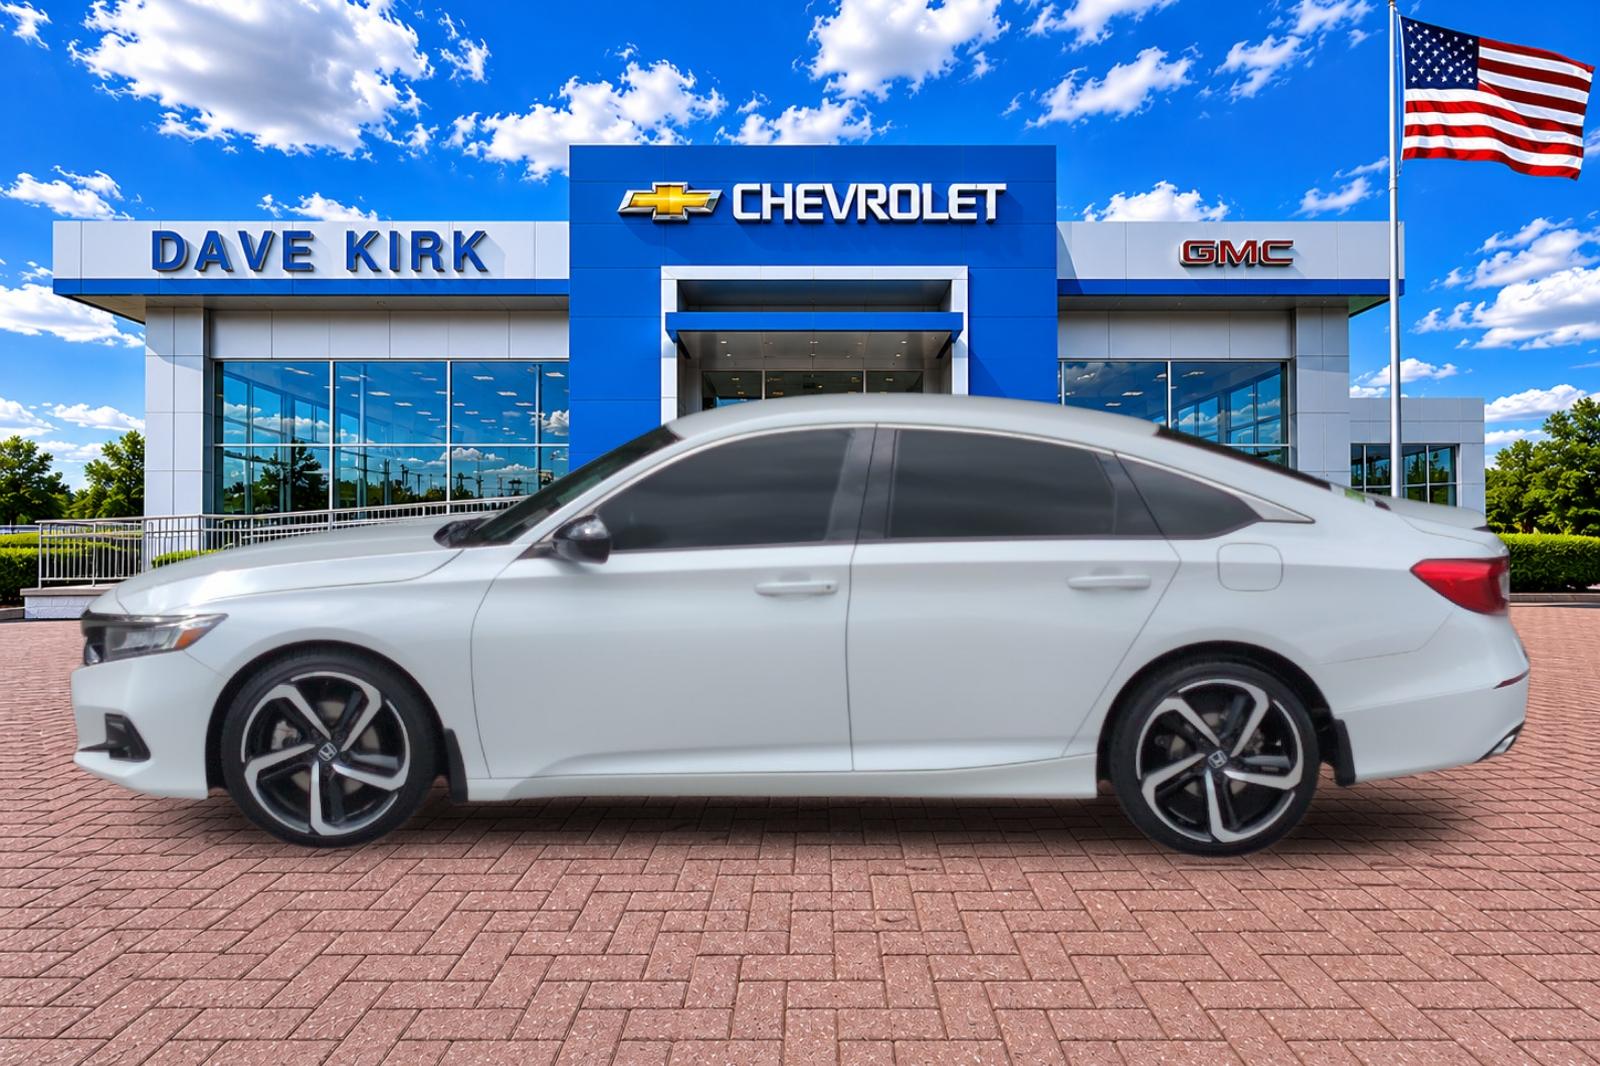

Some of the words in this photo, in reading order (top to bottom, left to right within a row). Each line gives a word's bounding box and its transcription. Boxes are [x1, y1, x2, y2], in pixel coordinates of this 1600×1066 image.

[732, 183, 1007, 222] CHEVROLET
[152, 230, 314, 272] DAVE
[346, 230, 489, 272] KIRK
[1180, 240, 1294, 266] GMC
